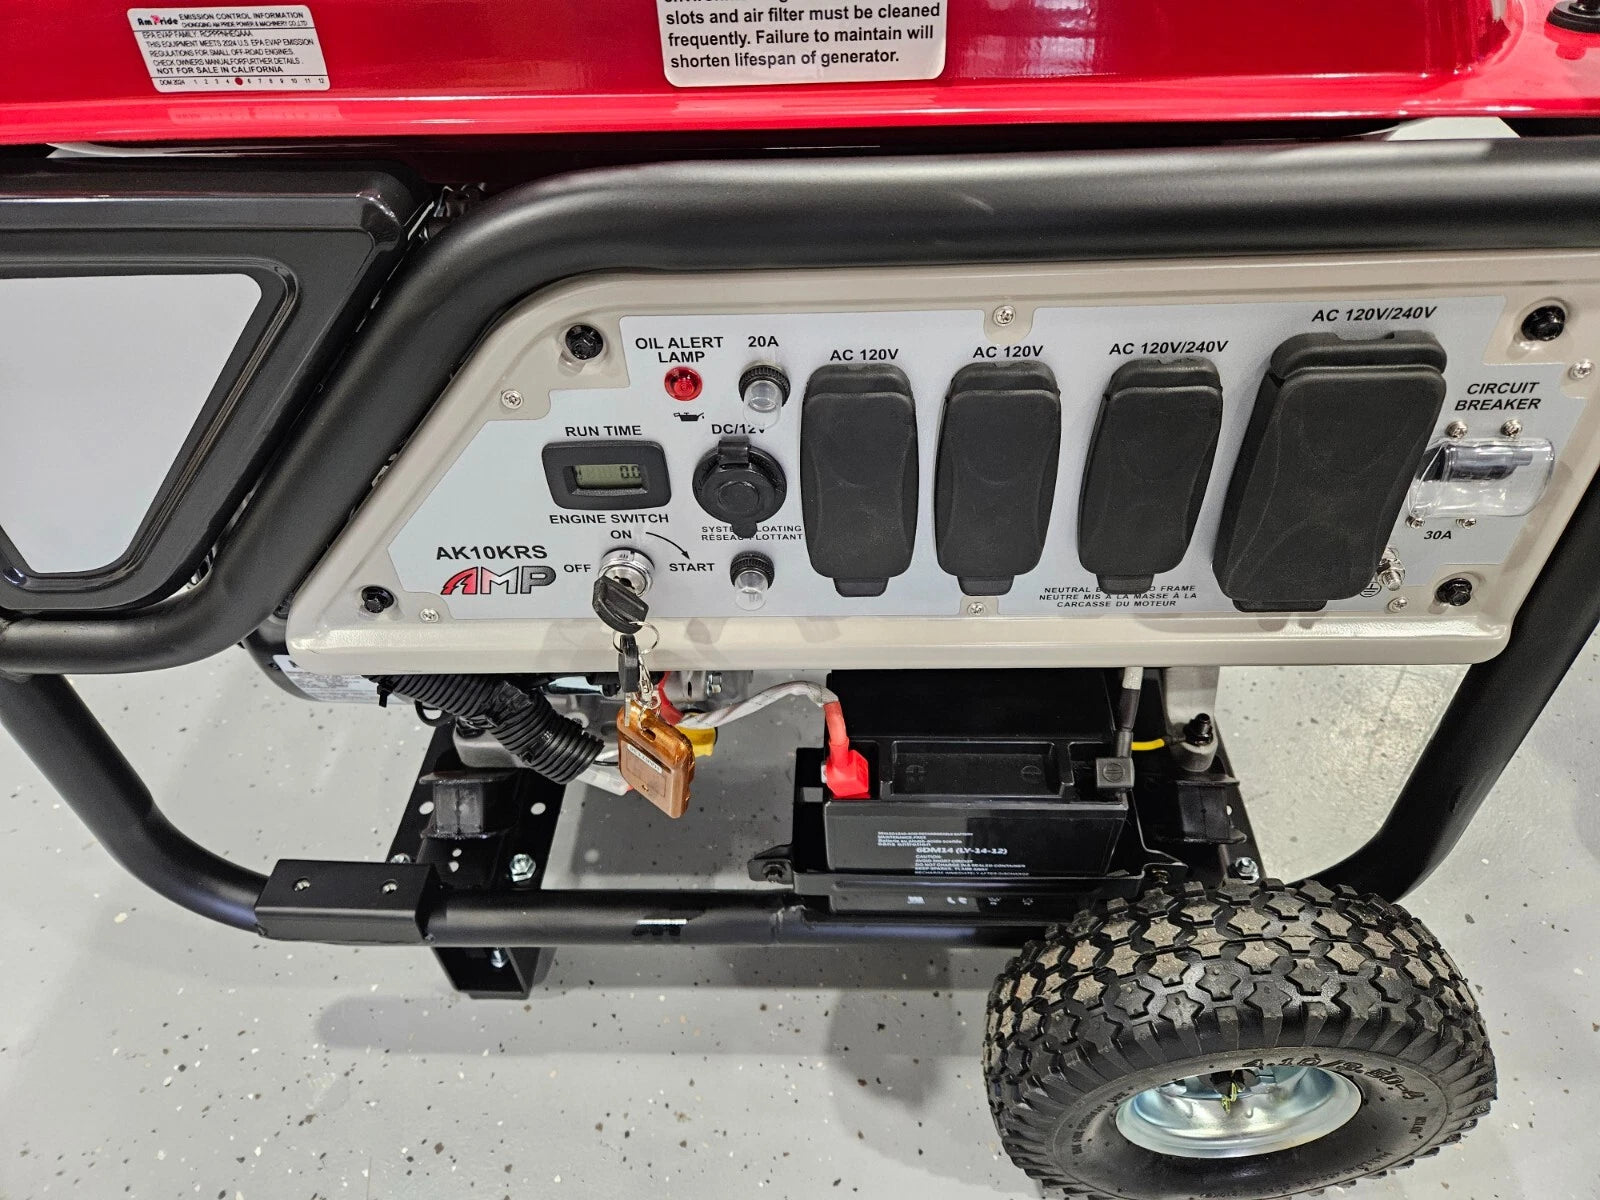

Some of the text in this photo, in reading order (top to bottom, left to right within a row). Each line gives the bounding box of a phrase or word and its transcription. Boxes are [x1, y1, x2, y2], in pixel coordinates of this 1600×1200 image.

[216, 12, 251, 20] CONTROL
[666, 2, 940, 25] slots and air filter must be cleaned
[668, 25, 934, 49] frequently. Failure to maintain will
[671, 50, 899, 68] shorten lifespan of generator.
[1312, 306, 1438, 322] AC 120V/240V
[635, 336, 724, 349] OIL ALERT
[748, 335, 779, 347] 20A
[1109, 340, 1229, 355] AC 120V/240V
[658, 351, 705, 363] LAMP
[830, 348, 899, 361] AC 120V
[973, 345, 1044, 359] AC 120V
[1466, 382, 1540, 395] CIRCUIT
[1454, 398, 1542, 411] BREAKER
[565, 425, 643, 437] RUN TIME
[549, 513, 669, 524] ENGINE SWITCH
[610, 530, 632, 539] ON
[1423, 530, 1452, 540] 30A
[436, 545, 548, 560] AK10KRS
[563, 564, 592, 573] OFF
[669, 563, 716, 572] START
[440, 565, 557, 595] AMP
[955, 847, 1008, 855] (LY-14-12)
